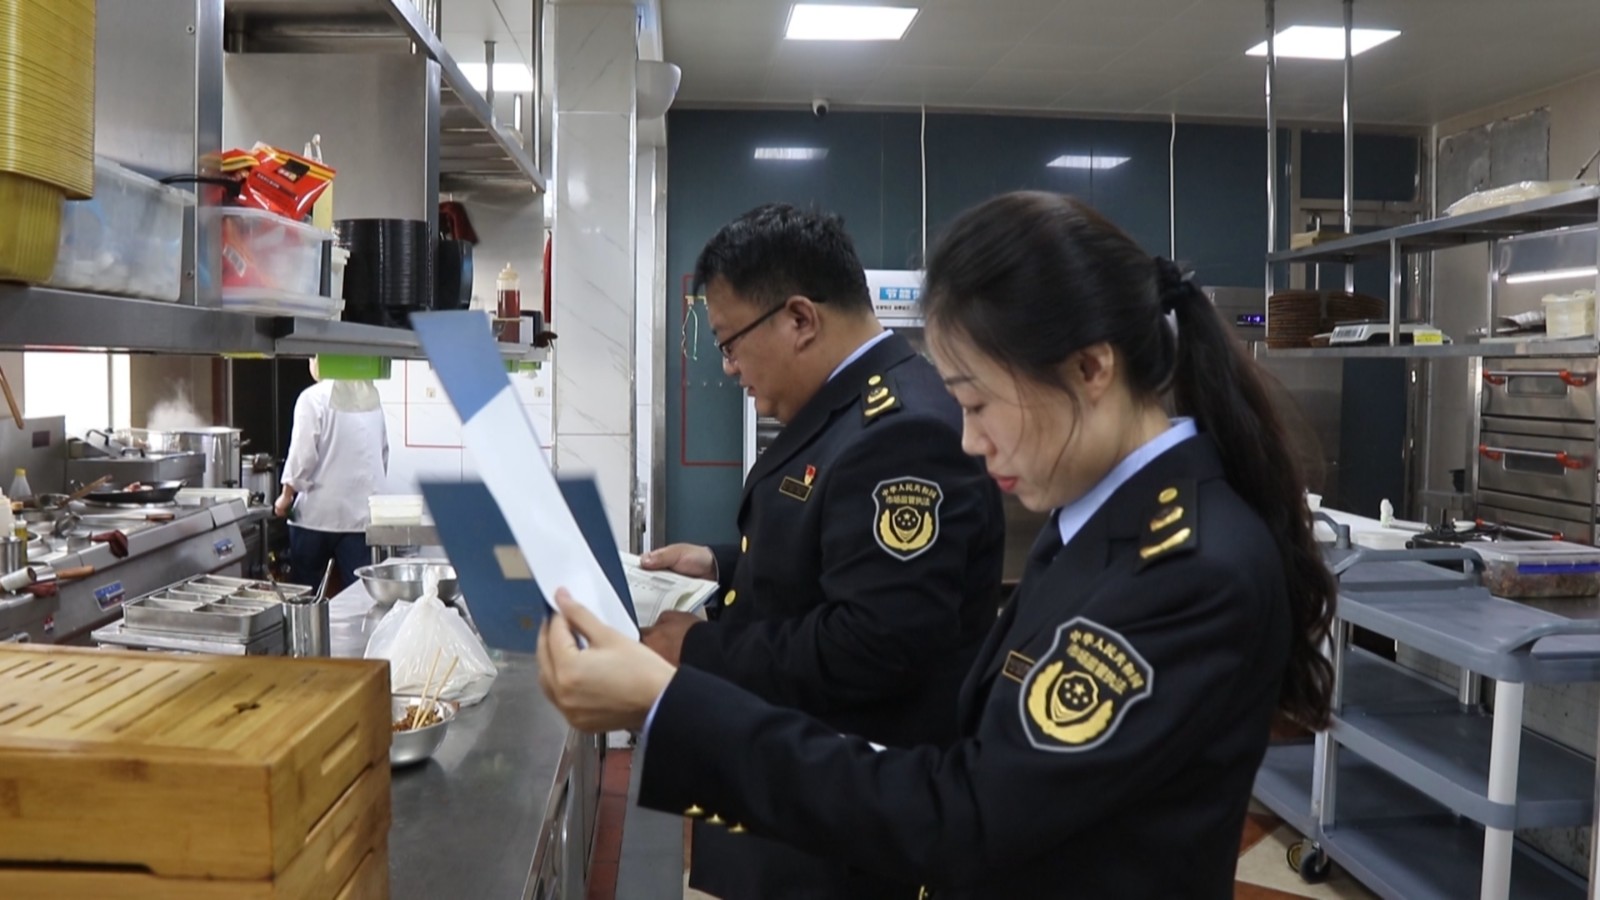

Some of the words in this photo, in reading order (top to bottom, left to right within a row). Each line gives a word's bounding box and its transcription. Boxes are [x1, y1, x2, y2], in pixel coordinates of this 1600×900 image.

[882, 483, 937, 499] 中华人民共和国
[1070, 630, 1144, 689] 中华人民共和国
